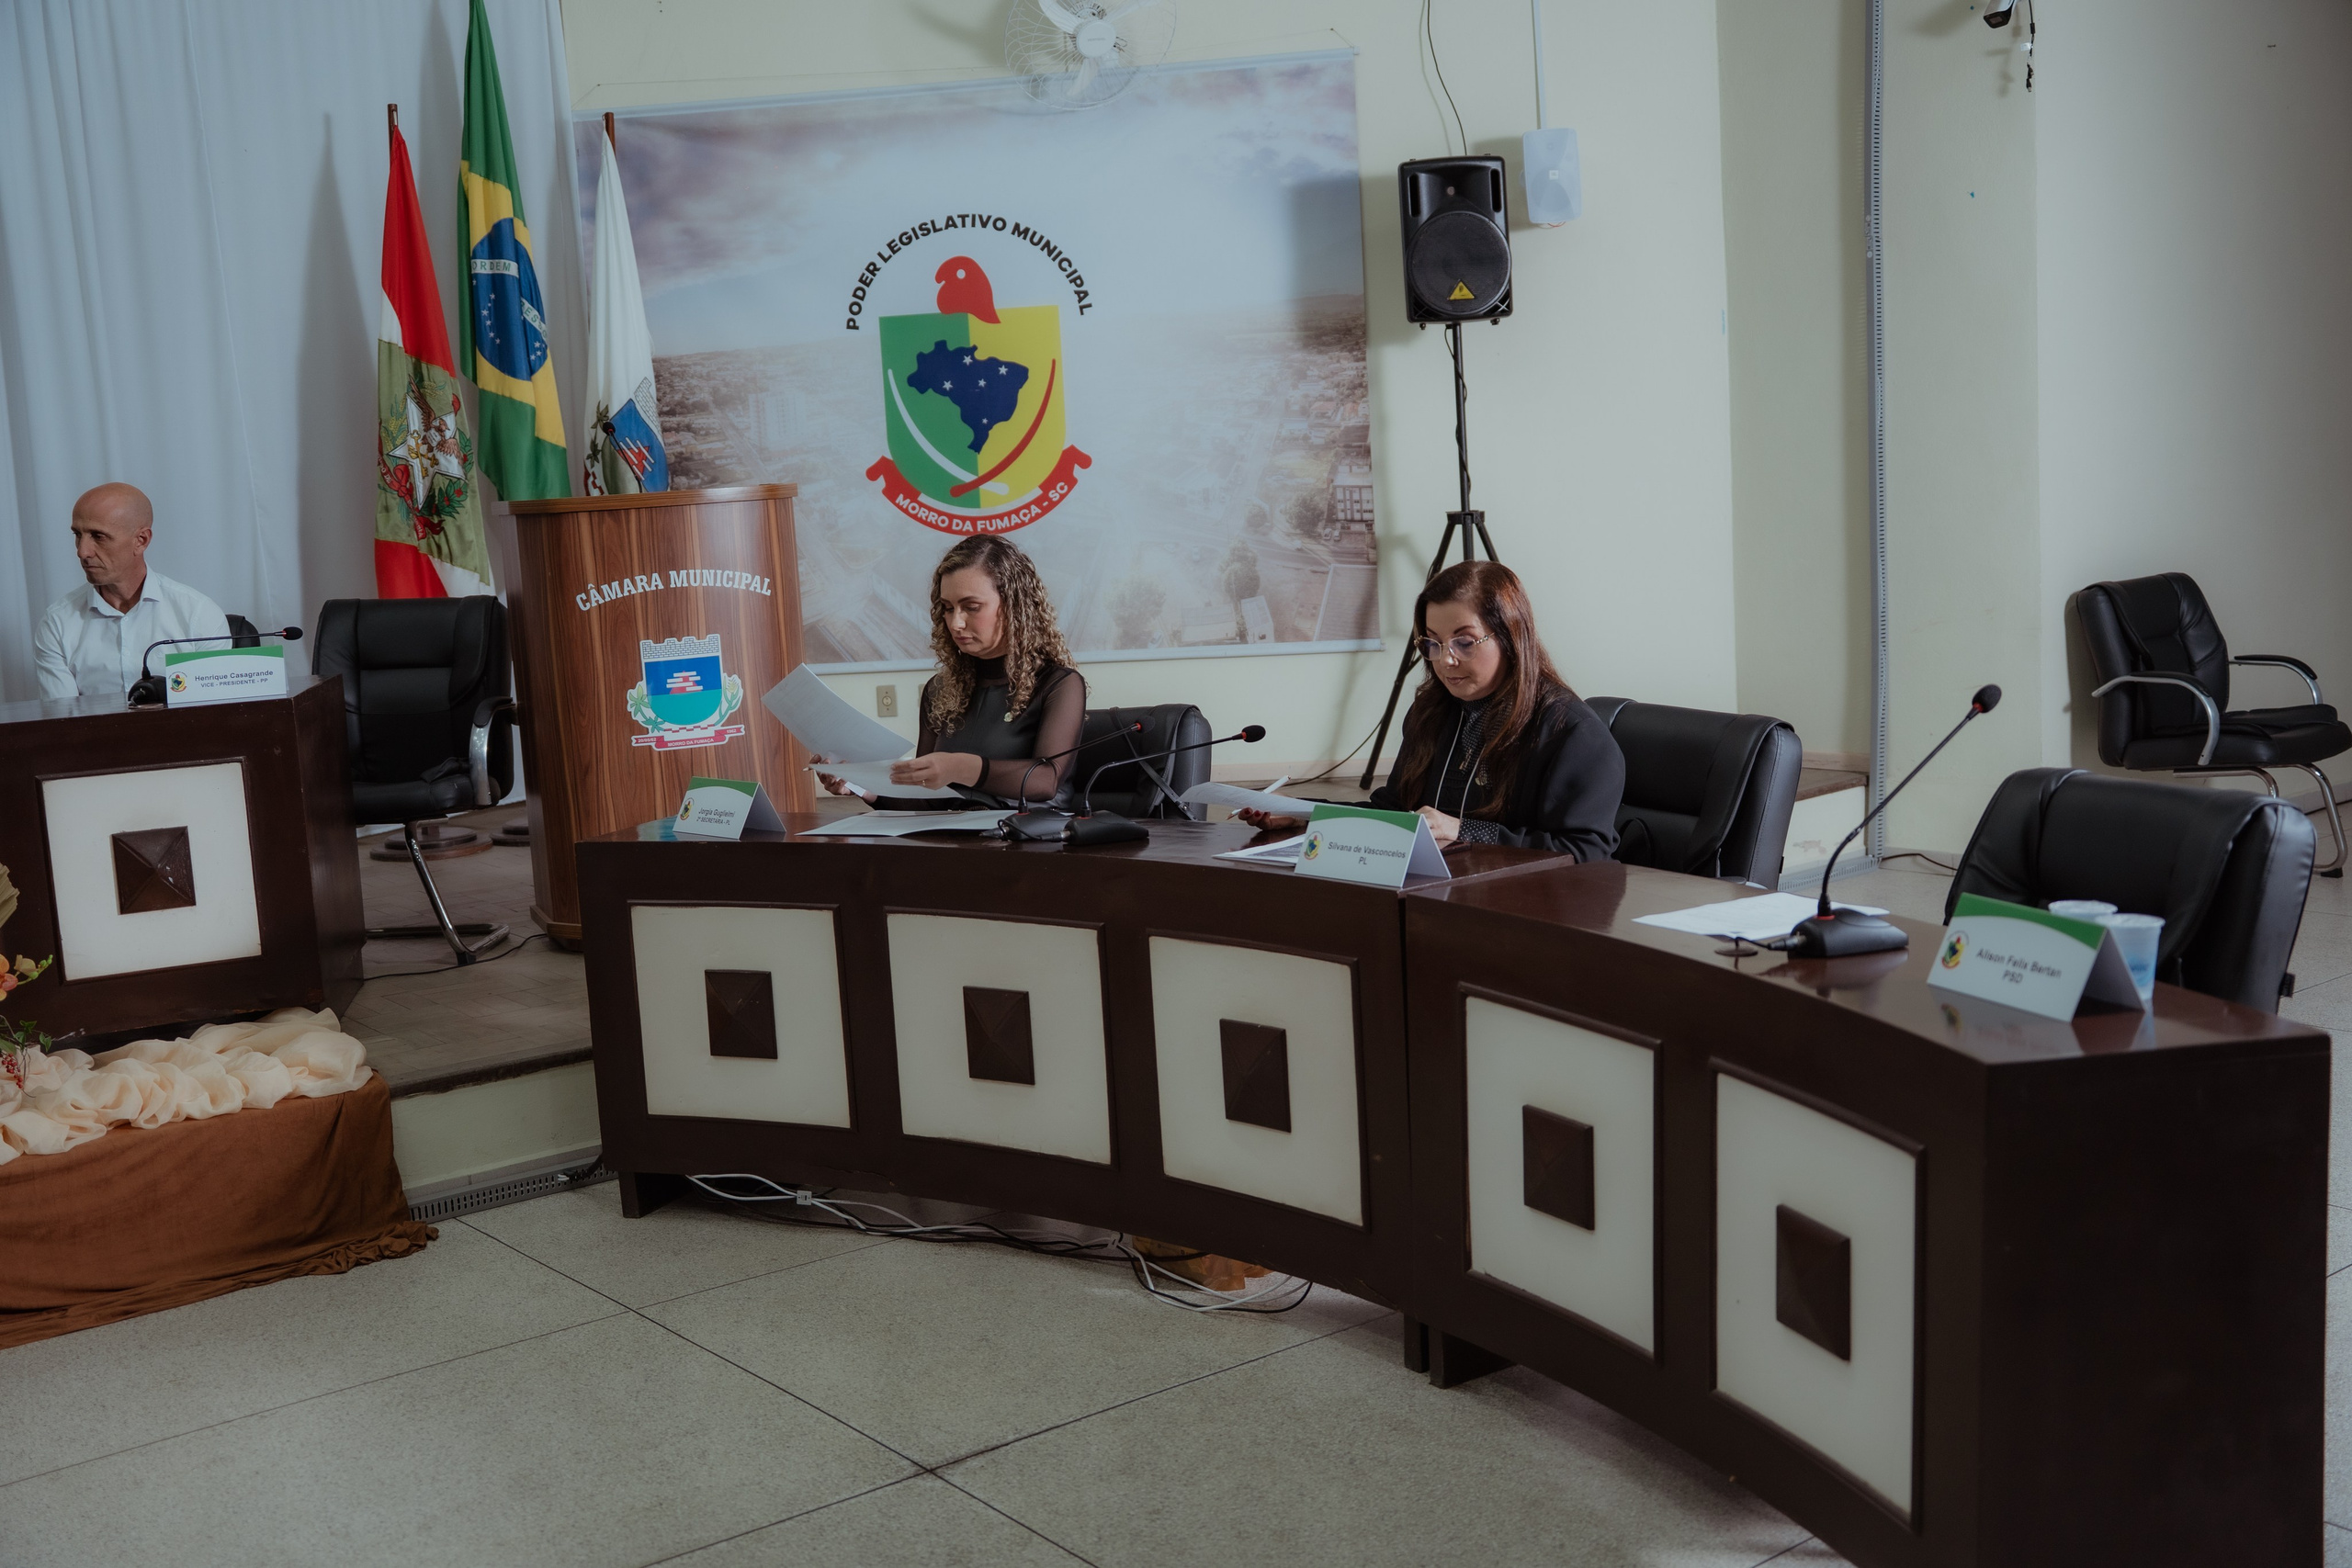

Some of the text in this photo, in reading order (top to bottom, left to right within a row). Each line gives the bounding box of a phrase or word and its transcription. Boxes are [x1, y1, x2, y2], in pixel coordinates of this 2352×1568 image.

[471, 261, 511, 272] ORDEM
[846, 213, 1093, 331] PODER LEGISLATIVO MUNICIPAL
[895, 493, 950, 528] MORRO
[952, 518, 974, 532] DA
[977, 504, 1043, 532] FUMAÇA
[1047, 481, 1069, 502] SC
[575, 569, 772, 612] CÂMARA MUNICIPAL
[230, 670, 274, 678] Casagrande
[1328, 841, 1406, 859] Silvana de Vasconcelos
[1358, 856, 1367, 865] PL
[2002, 970, 2023, 984] PSD
